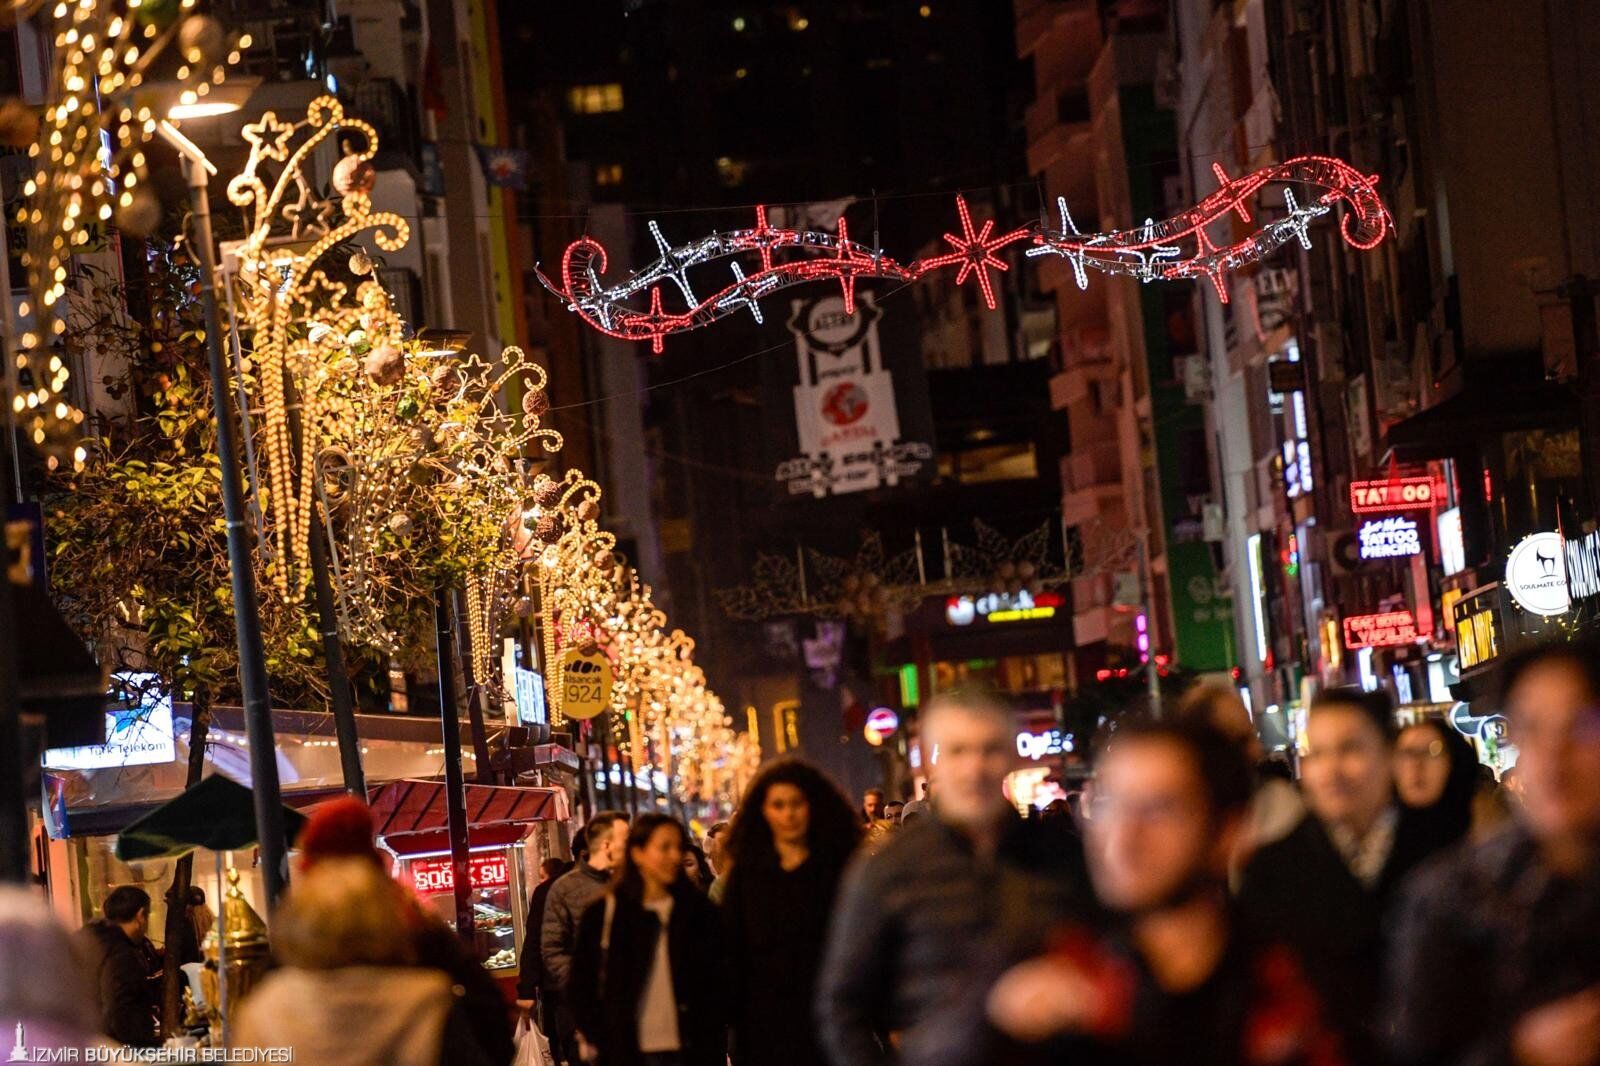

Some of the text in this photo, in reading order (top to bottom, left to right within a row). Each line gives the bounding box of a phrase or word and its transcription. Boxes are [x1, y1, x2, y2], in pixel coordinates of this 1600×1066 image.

[1354, 484, 1431, 506] TATOO
[1360, 529, 1418, 546] TATTOO
[1520, 580, 1554, 591] SOULMATE
[564, 684, 602, 703] 1924
[118, 742, 166, 754] Telekom
[416, 864, 505, 888] SOĞK SU
